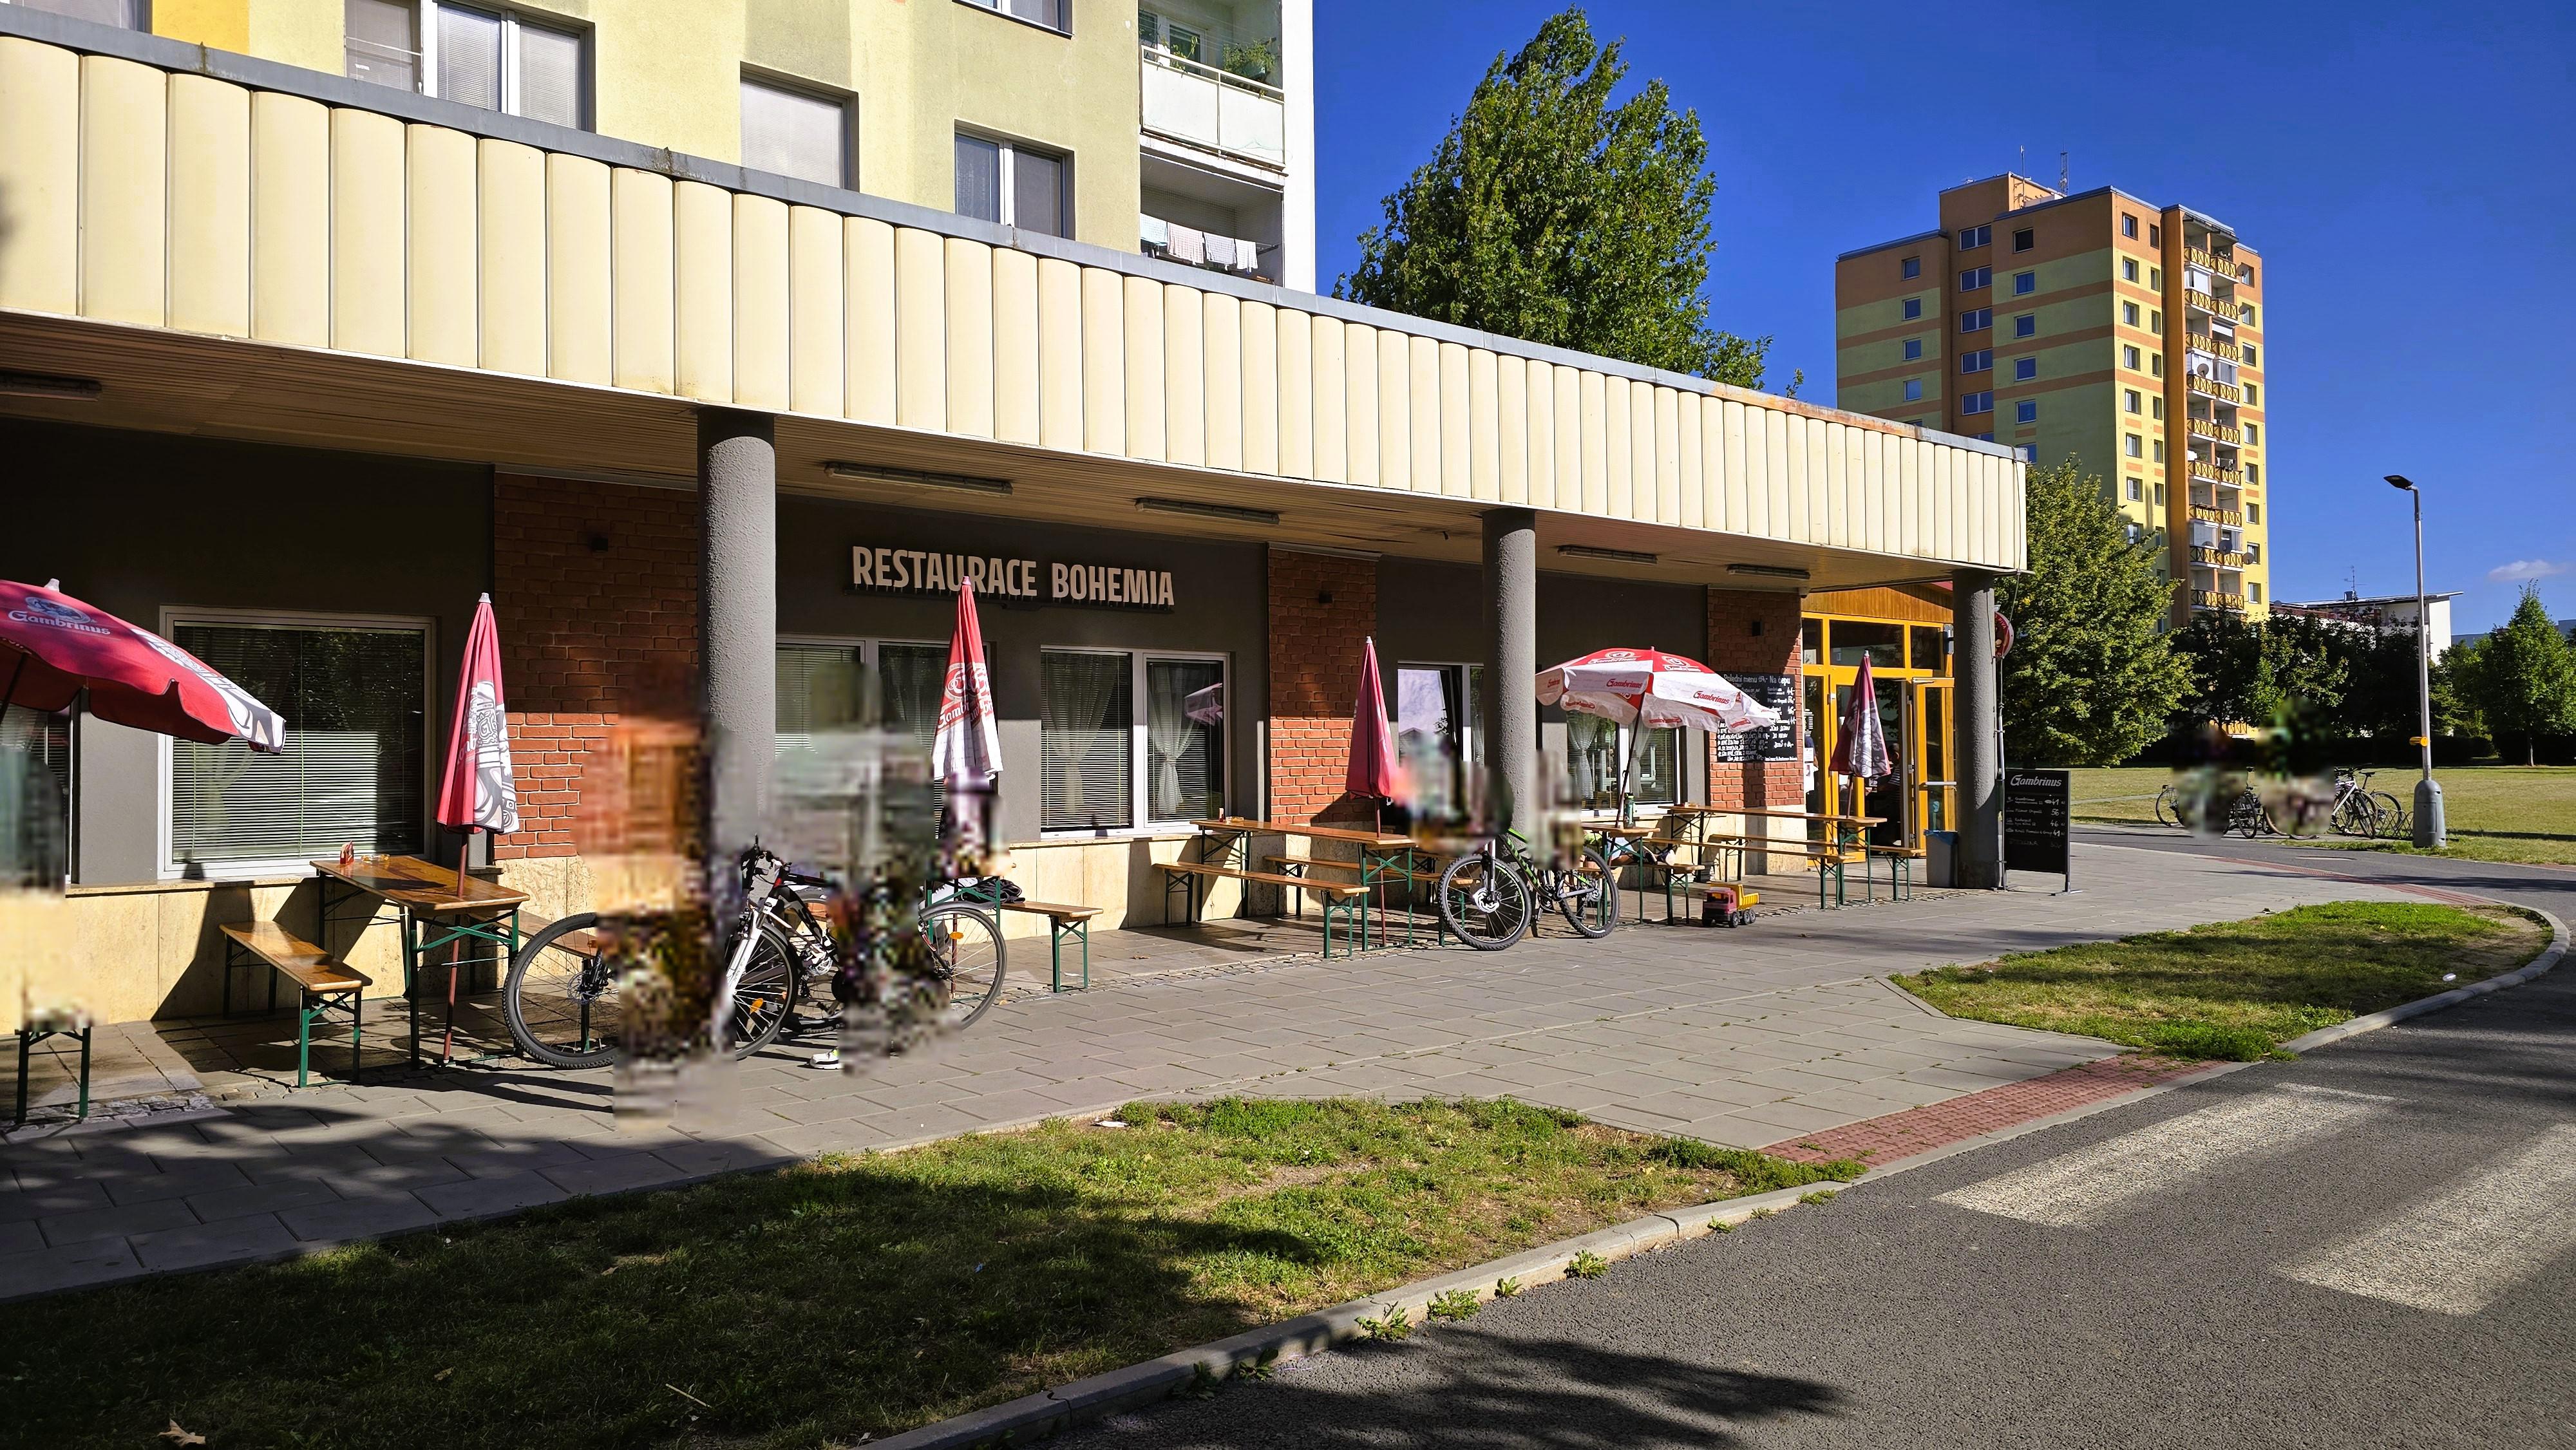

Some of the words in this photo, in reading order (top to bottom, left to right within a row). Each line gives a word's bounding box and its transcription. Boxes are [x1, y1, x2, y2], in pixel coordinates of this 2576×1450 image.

[853, 546, 1037, 597] RESTAURACE
[1052, 562, 1175, 607] BOHEMIA
[8, 610, 111, 635] Gambrinus
[1606, 678, 1643, 689] Gambrinus
[1769, 675, 1777, 684] Na
[1777, 676, 1791, 686] čepu
[1692, 690, 1730, 705] Gambrinus
[2010, 774, 2062, 787] Gambrinus
[2050, 808, 2060, 816] 56
[2050, 819, 2059, 827] 46
